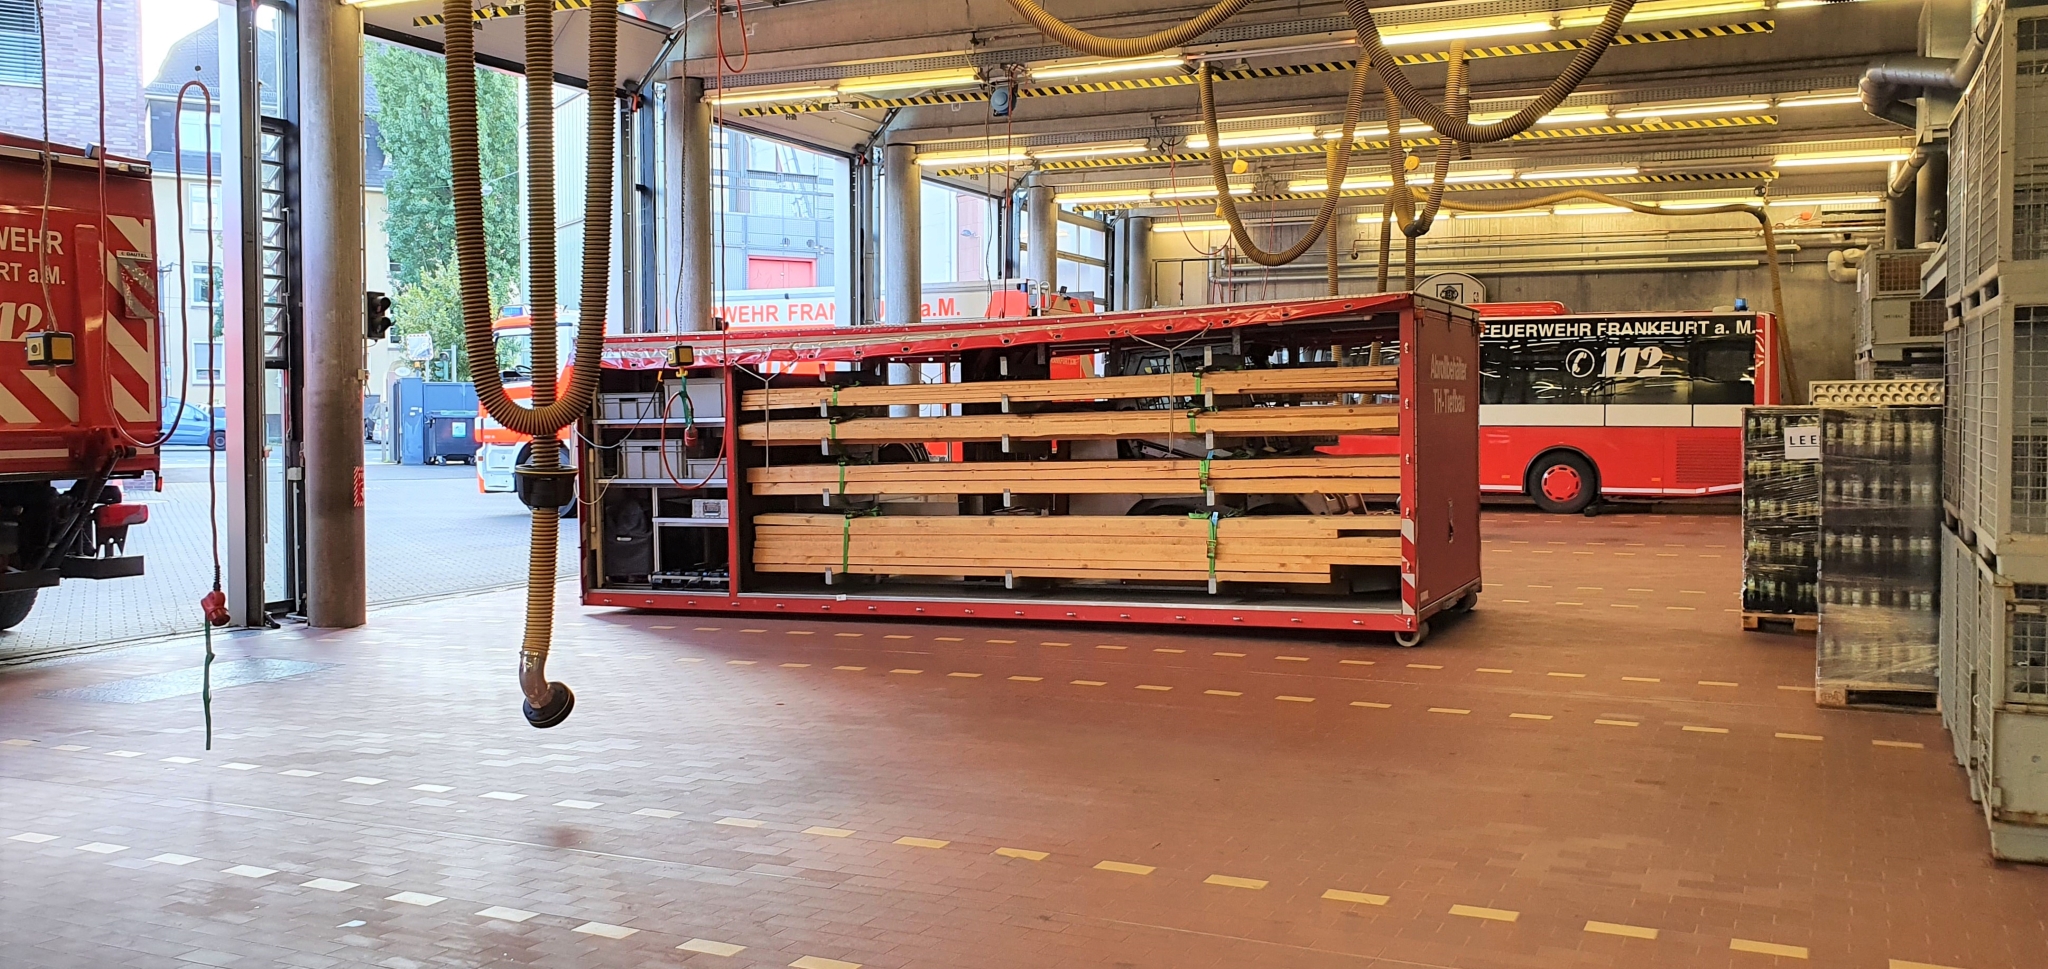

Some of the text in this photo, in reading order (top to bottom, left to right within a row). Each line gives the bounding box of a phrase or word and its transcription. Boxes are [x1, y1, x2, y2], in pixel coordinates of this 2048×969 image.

[1597, 320, 1710, 336] FRANKFURT
[1714, 322, 1730, 335] a.
[1736, 320, 1757, 335] M.
[1598, 346, 1663, 377] 112
